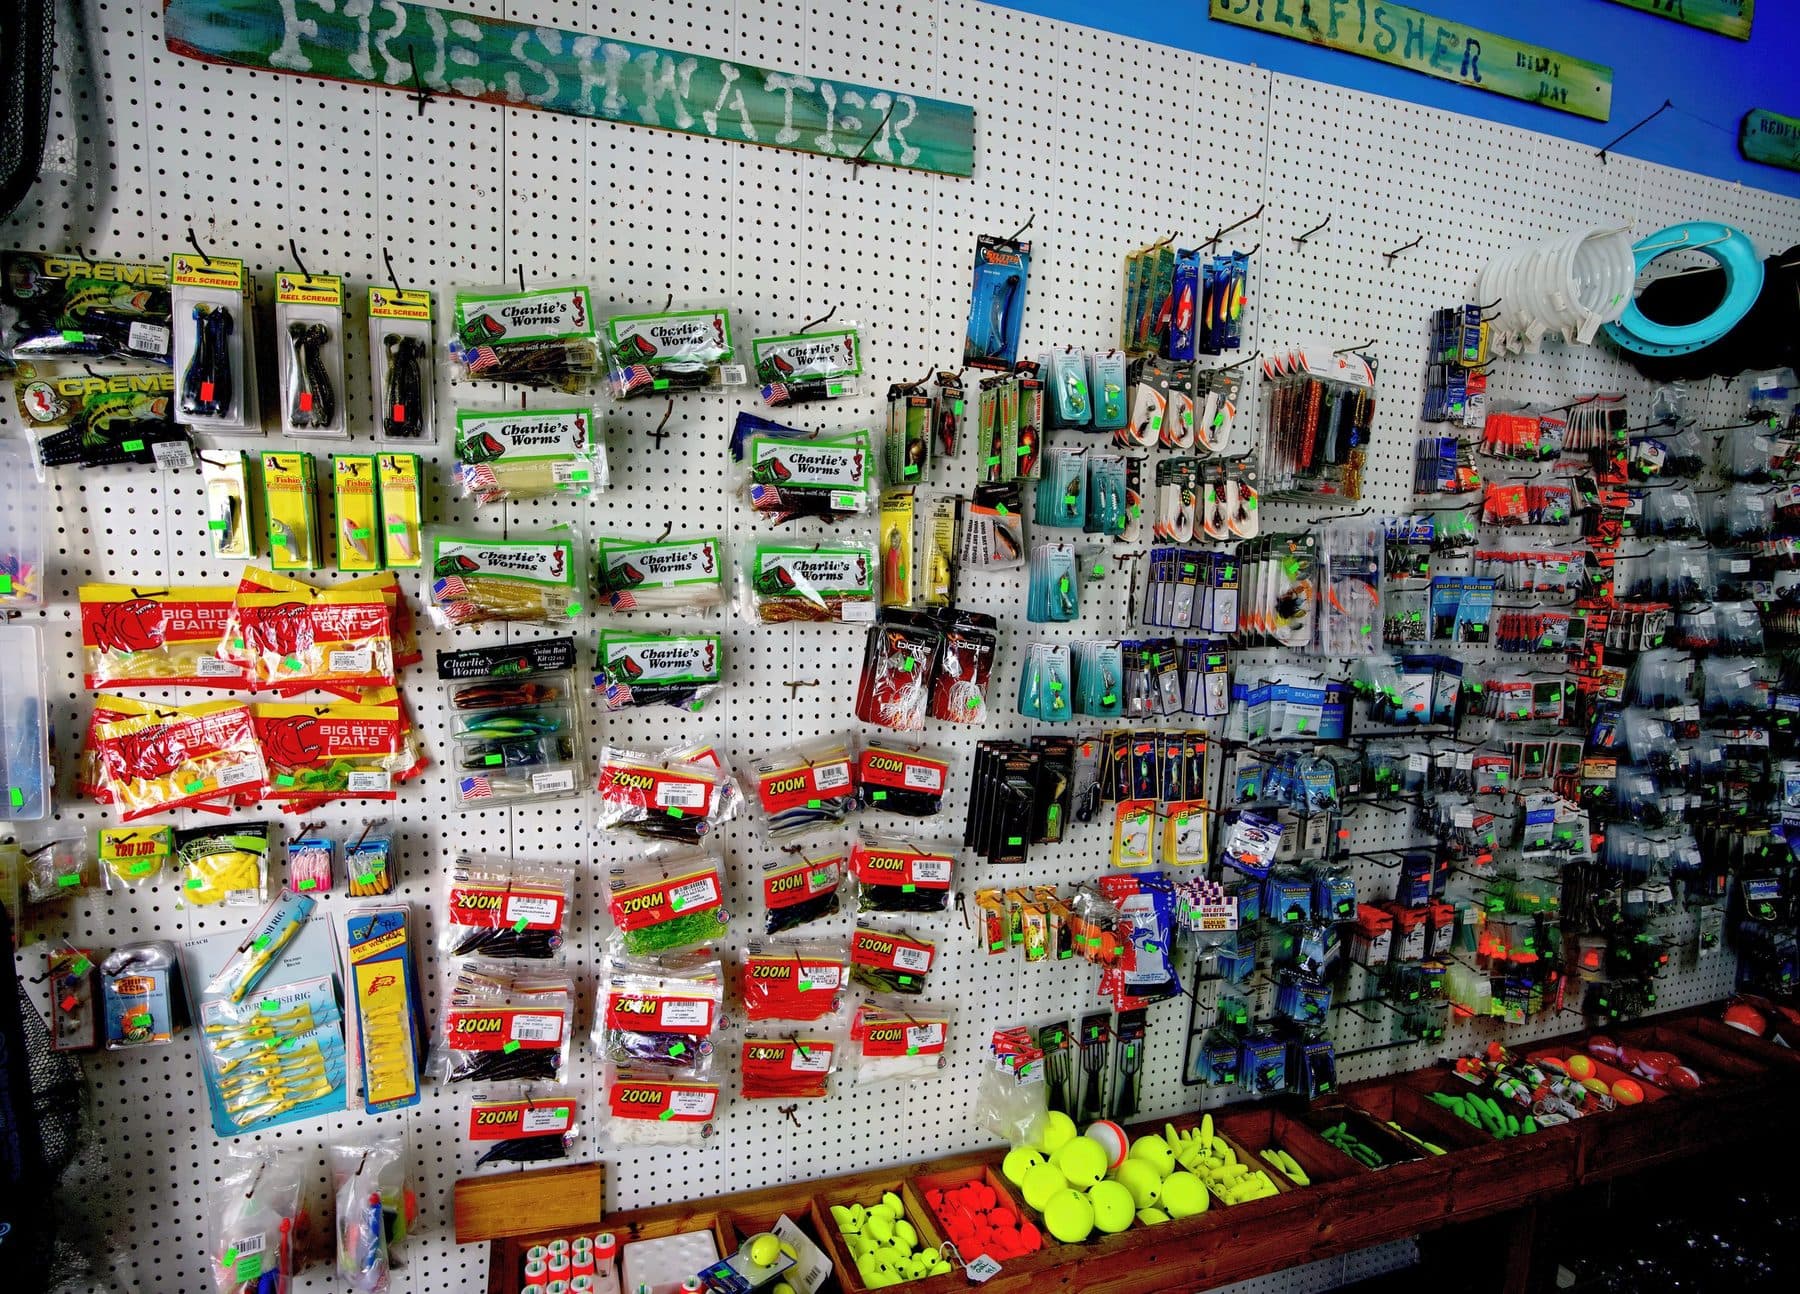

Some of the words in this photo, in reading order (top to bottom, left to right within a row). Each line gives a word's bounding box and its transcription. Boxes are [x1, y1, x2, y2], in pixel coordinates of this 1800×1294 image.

[1516, 51, 1561, 78] BILLY
[268, 0, 920, 165] FRESHWATER
[44, 261, 167, 285] CREME
[176, 276, 197, 284] REEL
[198, 277, 239, 287] SCREMER
[280, 293, 301, 301] REEL
[303, 295, 338, 303] SCREMER
[372, 308, 392, 316] REEL
[393, 309, 428, 317] SCREMER
[501, 301, 567, 318] Charlie's
[512, 314, 561, 327] Worms
[661, 335, 703, 347] Worms
[788, 344, 840, 358] Charlie's
[501, 422, 568, 436] Charlie's
[511, 434, 561, 446] Worms
[789, 453, 848, 466] Charlie's
[798, 464, 840, 475] Worms
[478, 551, 547, 563] Charlie's
[640, 552, 698, 566] Charlie's
[487, 558, 538, 571] Worms
[649, 561, 692, 573] Worms
[793, 560, 850, 572] Charlie's
[801, 571, 843, 581] Worms
[162, 609, 193, 619] BIG
[311, 610, 339, 621] BIG
[341, 609, 379, 620] BITE
[172, 620, 229, 630] BAITS
[321, 620, 372, 632] BAITS
[640, 648, 699, 659] Charlie's
[897, 641, 931, 653] blaze
[956, 641, 990, 653] blaze
[444, 656, 493, 669] Charlie's
[649, 658, 692, 669] Worms
[452, 666, 490, 677] Worms
[320, 725, 348, 735] BIG
[352, 726, 388, 736] BITE
[328, 736, 380, 746] BAITS
[869, 756, 904, 773] ZOOM
[612, 771, 654, 790] ZOOM
[770, 776, 805, 796] ZOOM
[115, 843, 134, 857] TRU
[868, 856, 904, 871] ZOOM
[771, 875, 804, 893] ZOOM
[1750, 880, 1778, 888] Mustad
[458, 894, 502, 909] ZOOM
[623, 892, 664, 914] ZOOM
[272, 910, 286, 926] RIG
[857, 937, 893, 955] ZOOM
[752, 965, 791, 979] ZOOM
[294, 991, 311, 1001] RIG
[615, 998, 657, 1014] ZOM
[457, 1018, 502, 1033] ZOOM
[869, 1028, 902, 1041] ZOOM
[621, 1089, 662, 1103] ZOOM
[477, 1109, 519, 1125] ZOOM
